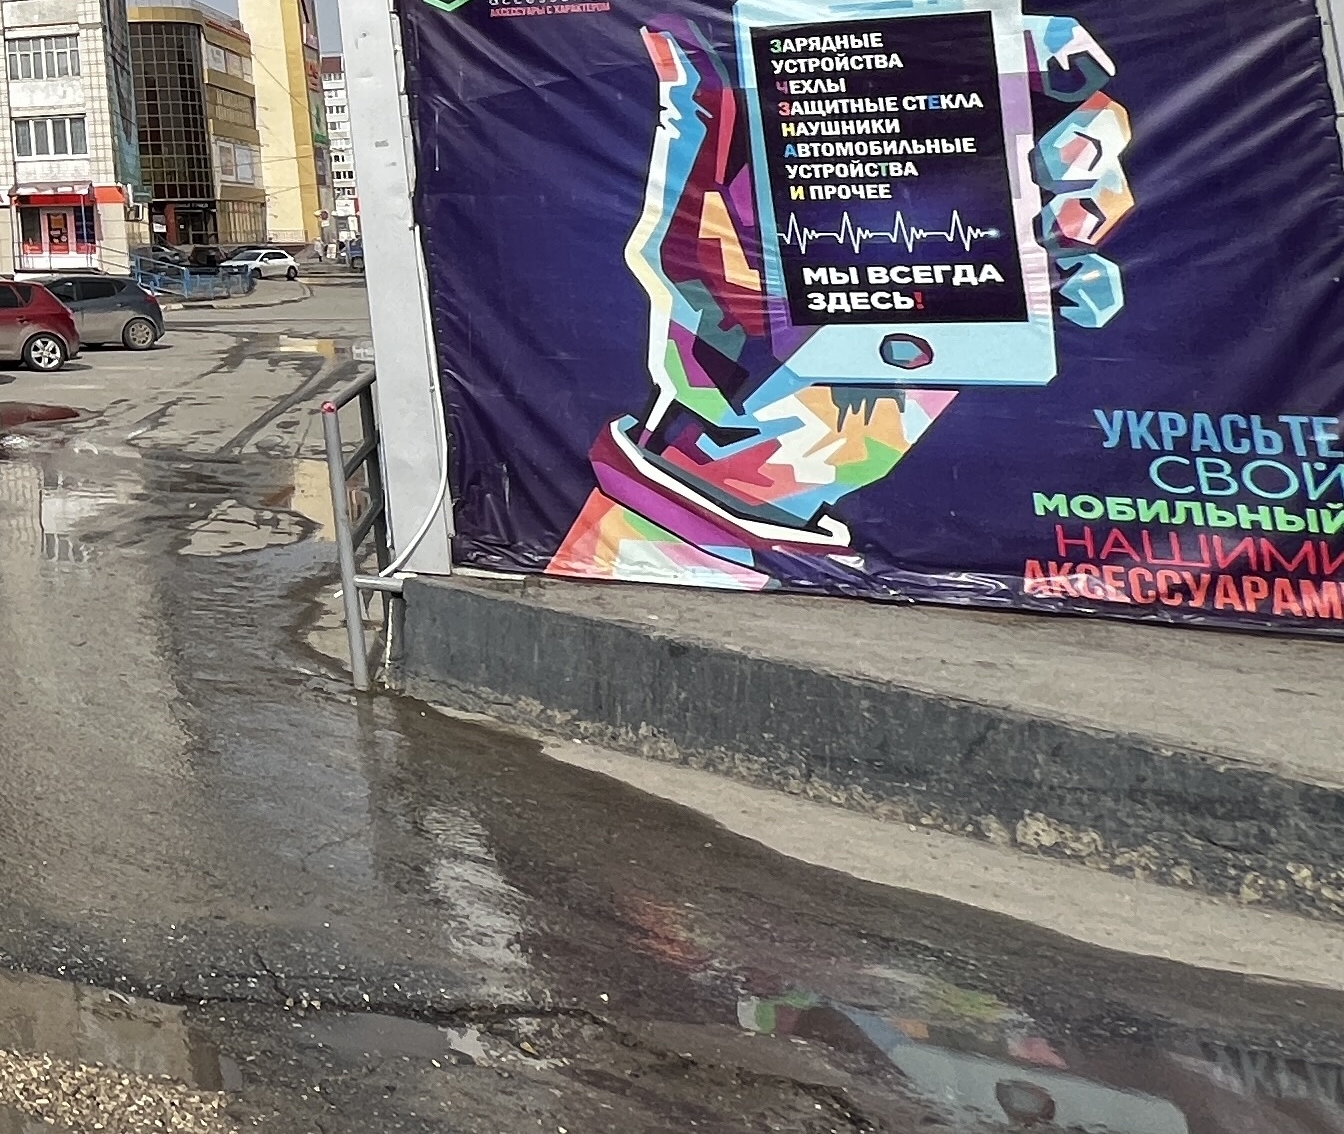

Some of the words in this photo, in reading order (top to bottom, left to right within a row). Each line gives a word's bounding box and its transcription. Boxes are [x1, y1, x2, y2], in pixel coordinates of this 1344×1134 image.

[489, 4, 546, 17] АКСЕССУАРЫ
[554, 2, 610, 14] ХАРАКТЕРОМ
[770, 32, 884, 54] ЗАРЯДНЫЕ
[771, 53, 904, 75] УСТРОЙСТВА
[776, 77, 847, 95] ЧЕХЛЫ
[777, 96, 899, 117] ЗАЩИТНЫЕ
[902, 93, 984, 111] СТЕКЛА
[781, 119, 901, 138] НАУШНИКИ
[784, 137, 977, 158] АВТОМОБИЛЬНЫЕ
[785, 158, 920, 179] УСТРОЙСТВА
[789, 185, 805, 201] И
[809, 184, 893, 200] ПРОЧЕЕ
[802, 266, 859, 285] МЫ
[867, 264, 1005, 286] ВСЕГДА
[806, 291, 926, 313] ЗДЕСЬ!
[1093, 408, 1344, 458] УКРАСЬТЕ
[1148, 455, 1344, 500] СВОЙ
[1032, 492, 1344, 534] МОБИЛЬНЫЙ
[1055, 524, 1344, 574] НАШИМИ
[1023, 559, 1344, 620] АКСЕССУАРАМ
